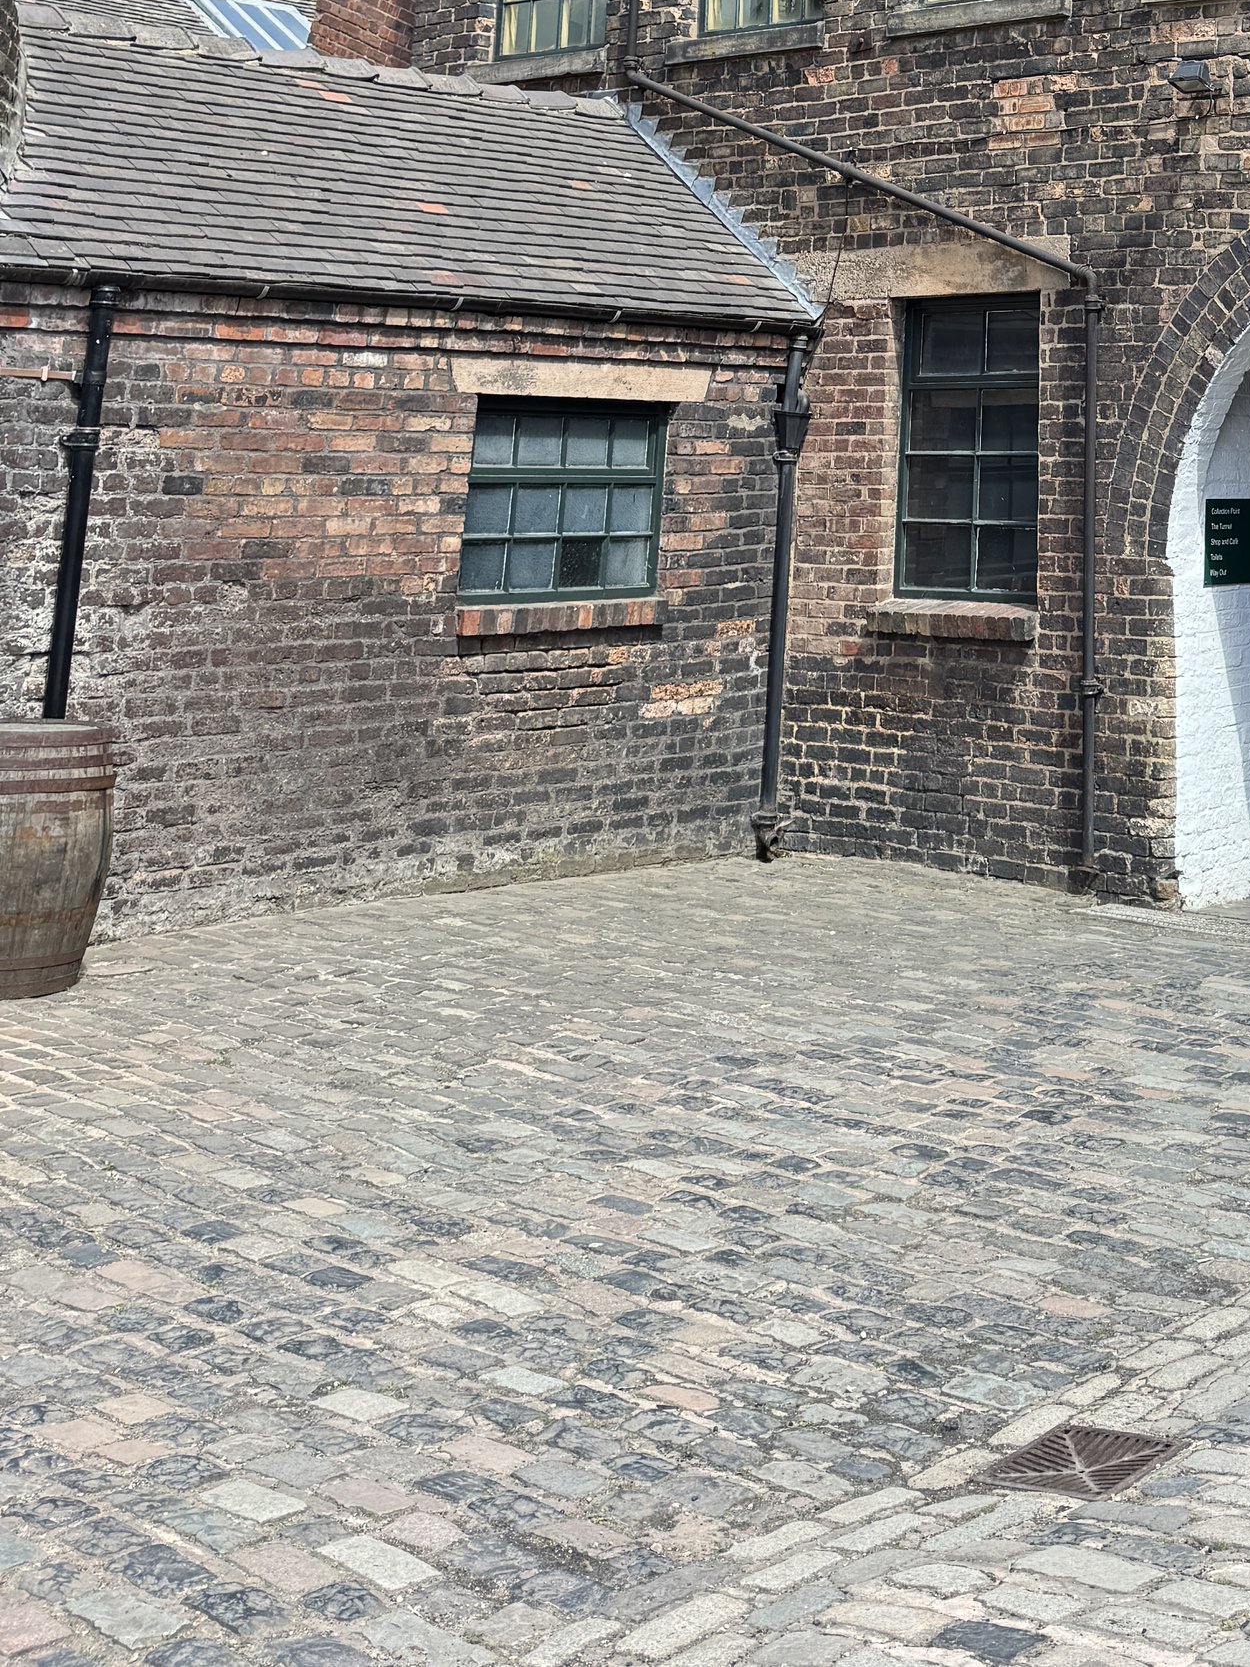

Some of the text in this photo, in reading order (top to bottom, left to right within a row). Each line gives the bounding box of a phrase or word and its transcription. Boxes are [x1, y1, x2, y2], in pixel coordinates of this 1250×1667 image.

[1211, 507, 1241, 515] Collection Point
[1211, 522, 1219, 530] The
[1210, 538, 1221, 546] Shop
[1210, 553, 1223, 561] Toilets
[1210, 568, 1227, 578] Way Out
